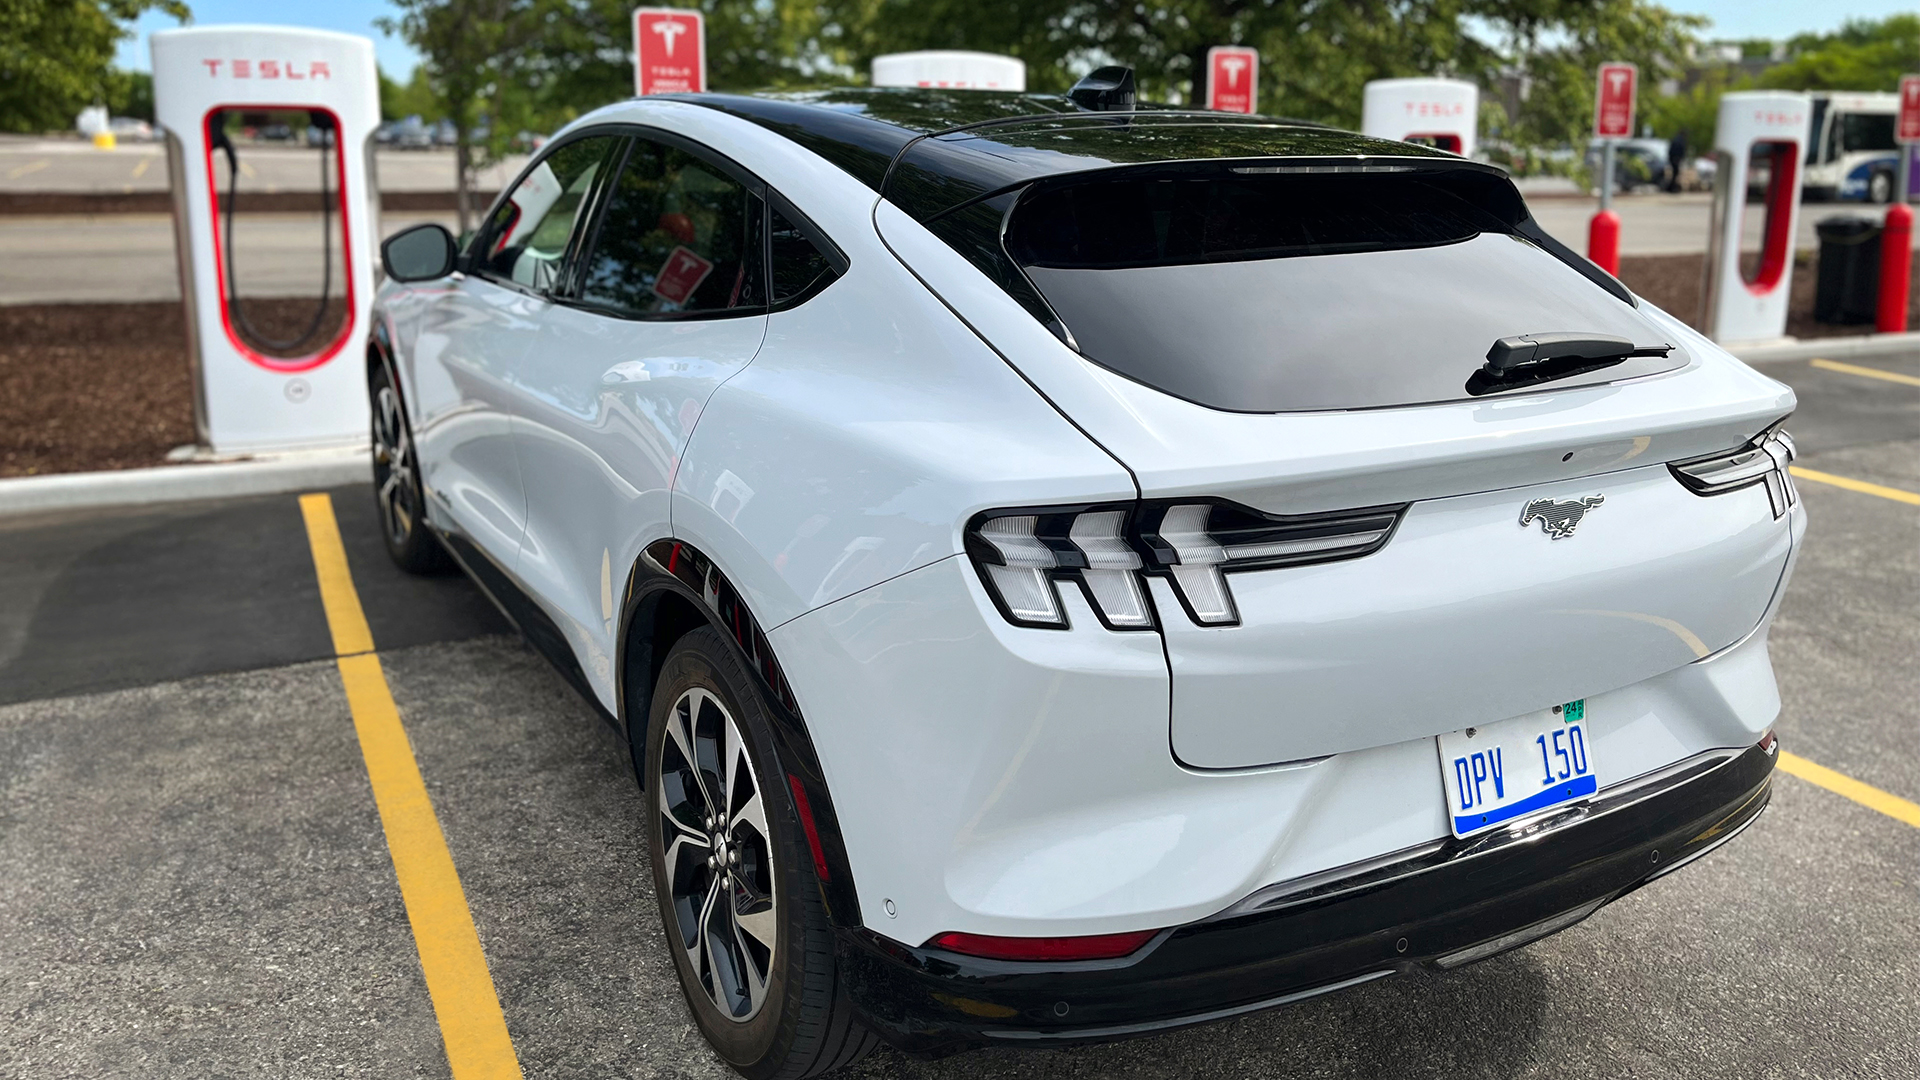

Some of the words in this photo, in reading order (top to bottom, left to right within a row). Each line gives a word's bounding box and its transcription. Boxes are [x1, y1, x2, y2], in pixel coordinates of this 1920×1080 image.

[202, 59, 331, 80] TESLA
[651, 65, 691, 76] TESLA
[1404, 102, 1463, 116] TESLA
[1565, 702, 1577, 714] 24
[1454, 747, 1505, 810] DPV
[1537, 725, 1587, 785] 150
